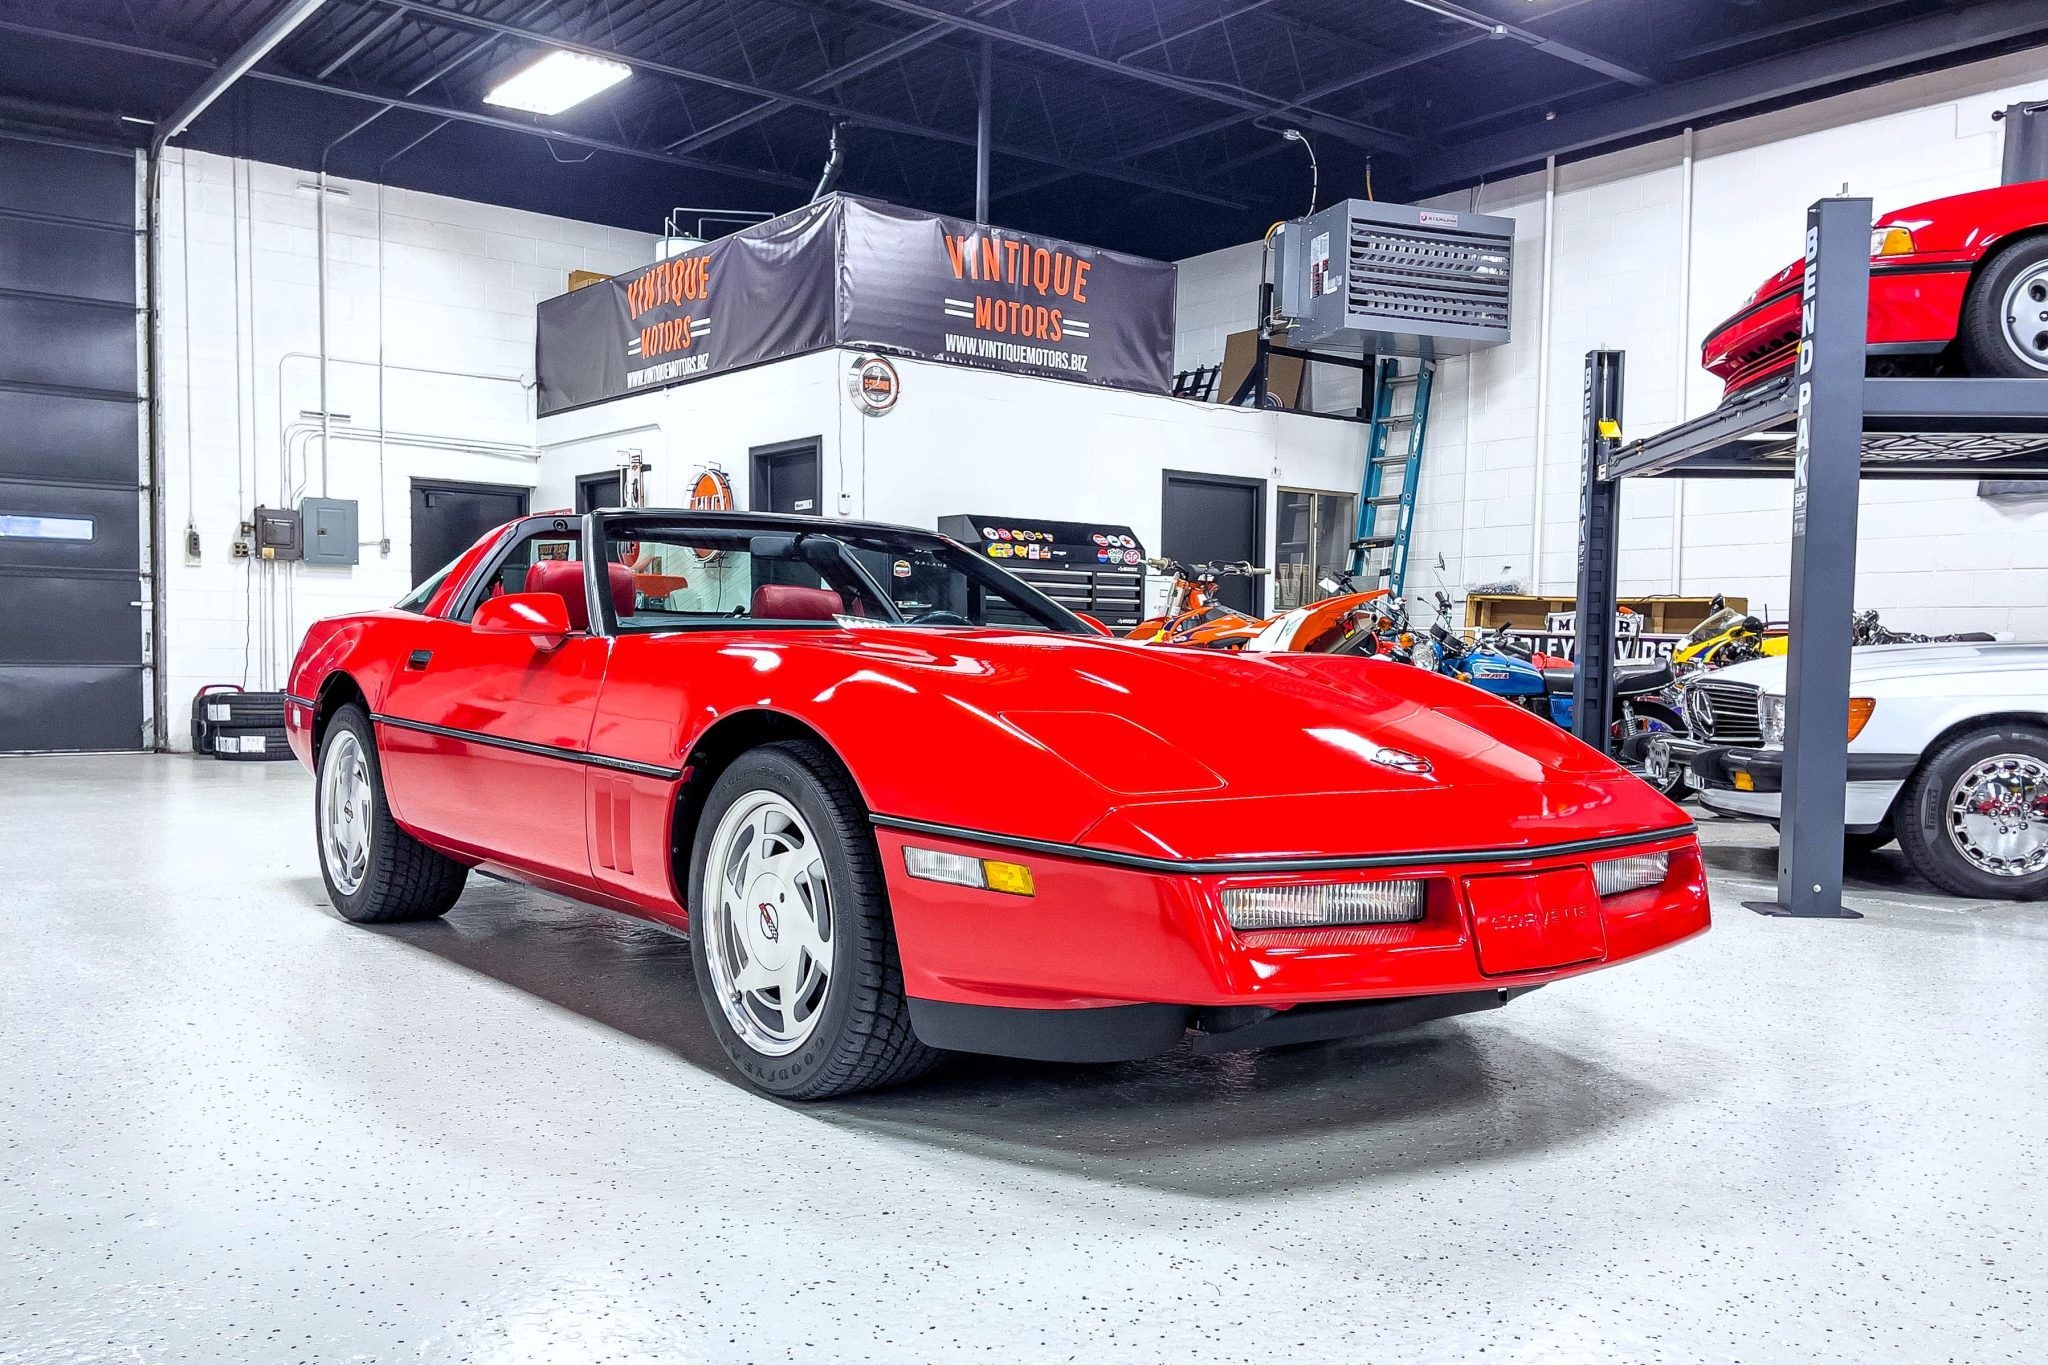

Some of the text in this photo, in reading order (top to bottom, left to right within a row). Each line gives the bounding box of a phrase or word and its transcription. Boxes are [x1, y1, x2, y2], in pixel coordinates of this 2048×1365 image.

[627, 256, 711, 320] VINTIQUE
[945, 235, 1091, 304] VINTIQUE
[641, 315, 692, 359] MOTORS
[975, 296, 1062, 342] MOTORS
[626, 352, 710, 389] WWW.VINTIQUEMOTORS.BIZ
[945, 333, 1088, 373] WWW.VINTIQUEMOTORS.BIZ
[1794, 226, 1819, 488] BENDPAK
[1125, 551, 1140, 563] STP
[1491, 905, 1590, 931] CORVETTE
